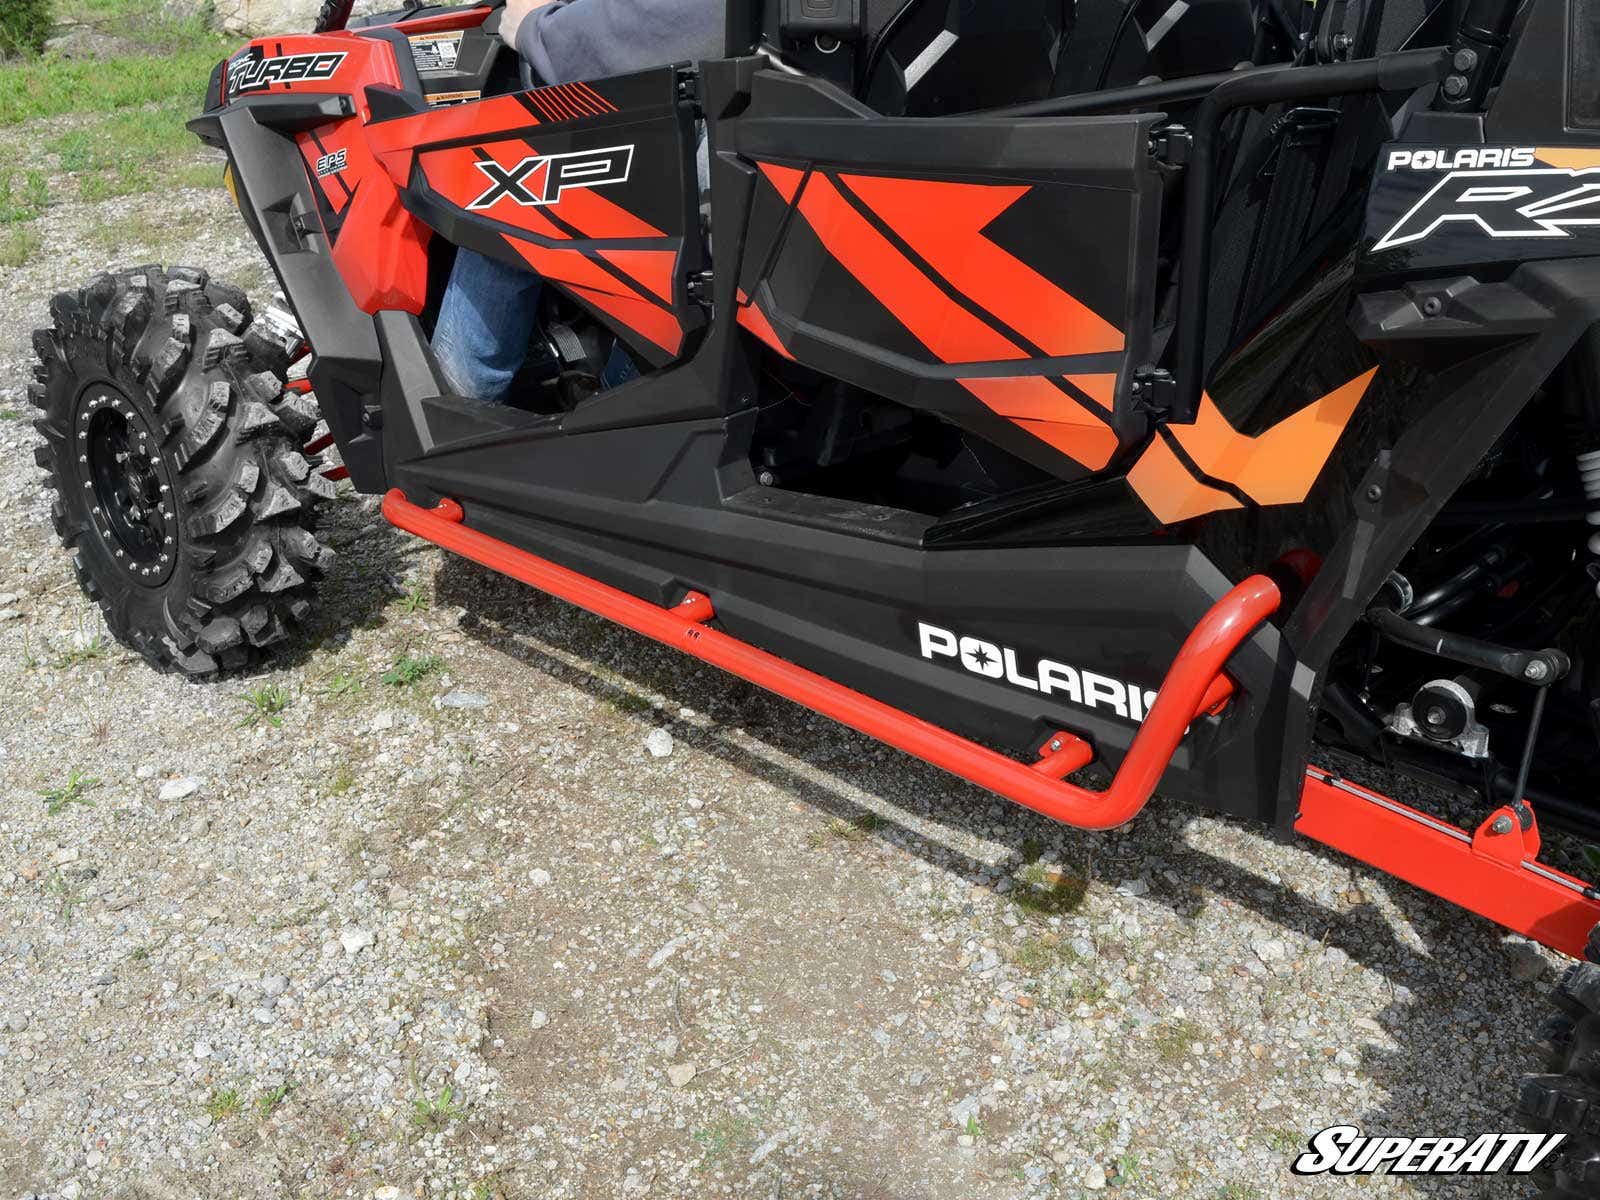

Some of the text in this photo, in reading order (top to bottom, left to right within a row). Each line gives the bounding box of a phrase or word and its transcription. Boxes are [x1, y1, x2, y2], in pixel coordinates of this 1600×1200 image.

[229, 51, 348, 94] TURBO
[316, 147, 347, 171] EPS
[1386, 147, 1536, 171] POLARIS
[464, 144, 635, 211] XP
